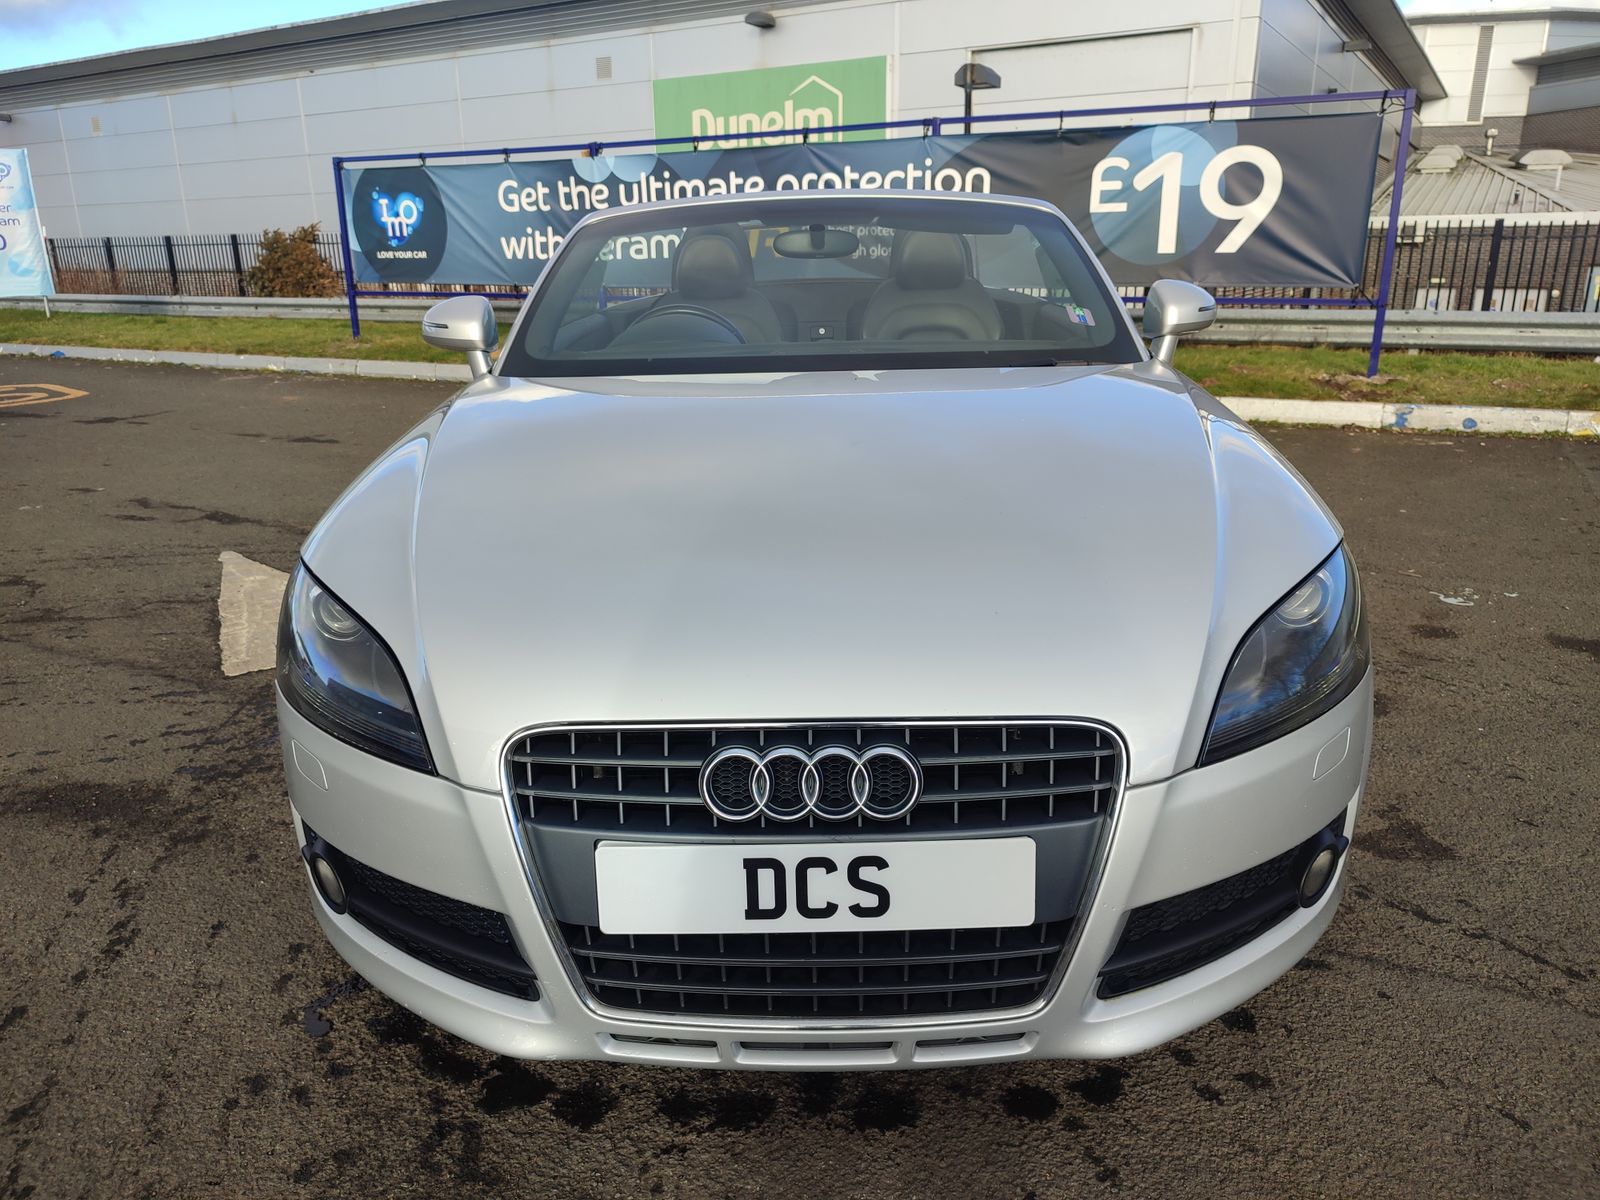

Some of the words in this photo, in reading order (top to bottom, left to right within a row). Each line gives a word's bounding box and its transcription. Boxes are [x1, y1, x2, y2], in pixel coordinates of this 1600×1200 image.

[691, 99, 833, 151] Dunelm
[498, 179, 551, 213] Get
[557, 176, 609, 212] the
[619, 170, 765, 206] ultimate
[776, 157, 991, 194] protection
[1089, 145, 1283, 254] £19
[377, 250, 394, 259] LOVE
[394, 250, 413, 259] YOUR
[413, 250, 427, 259] CAR
[500, 226, 566, 261] with
[743, 855, 890, 920] DCS
